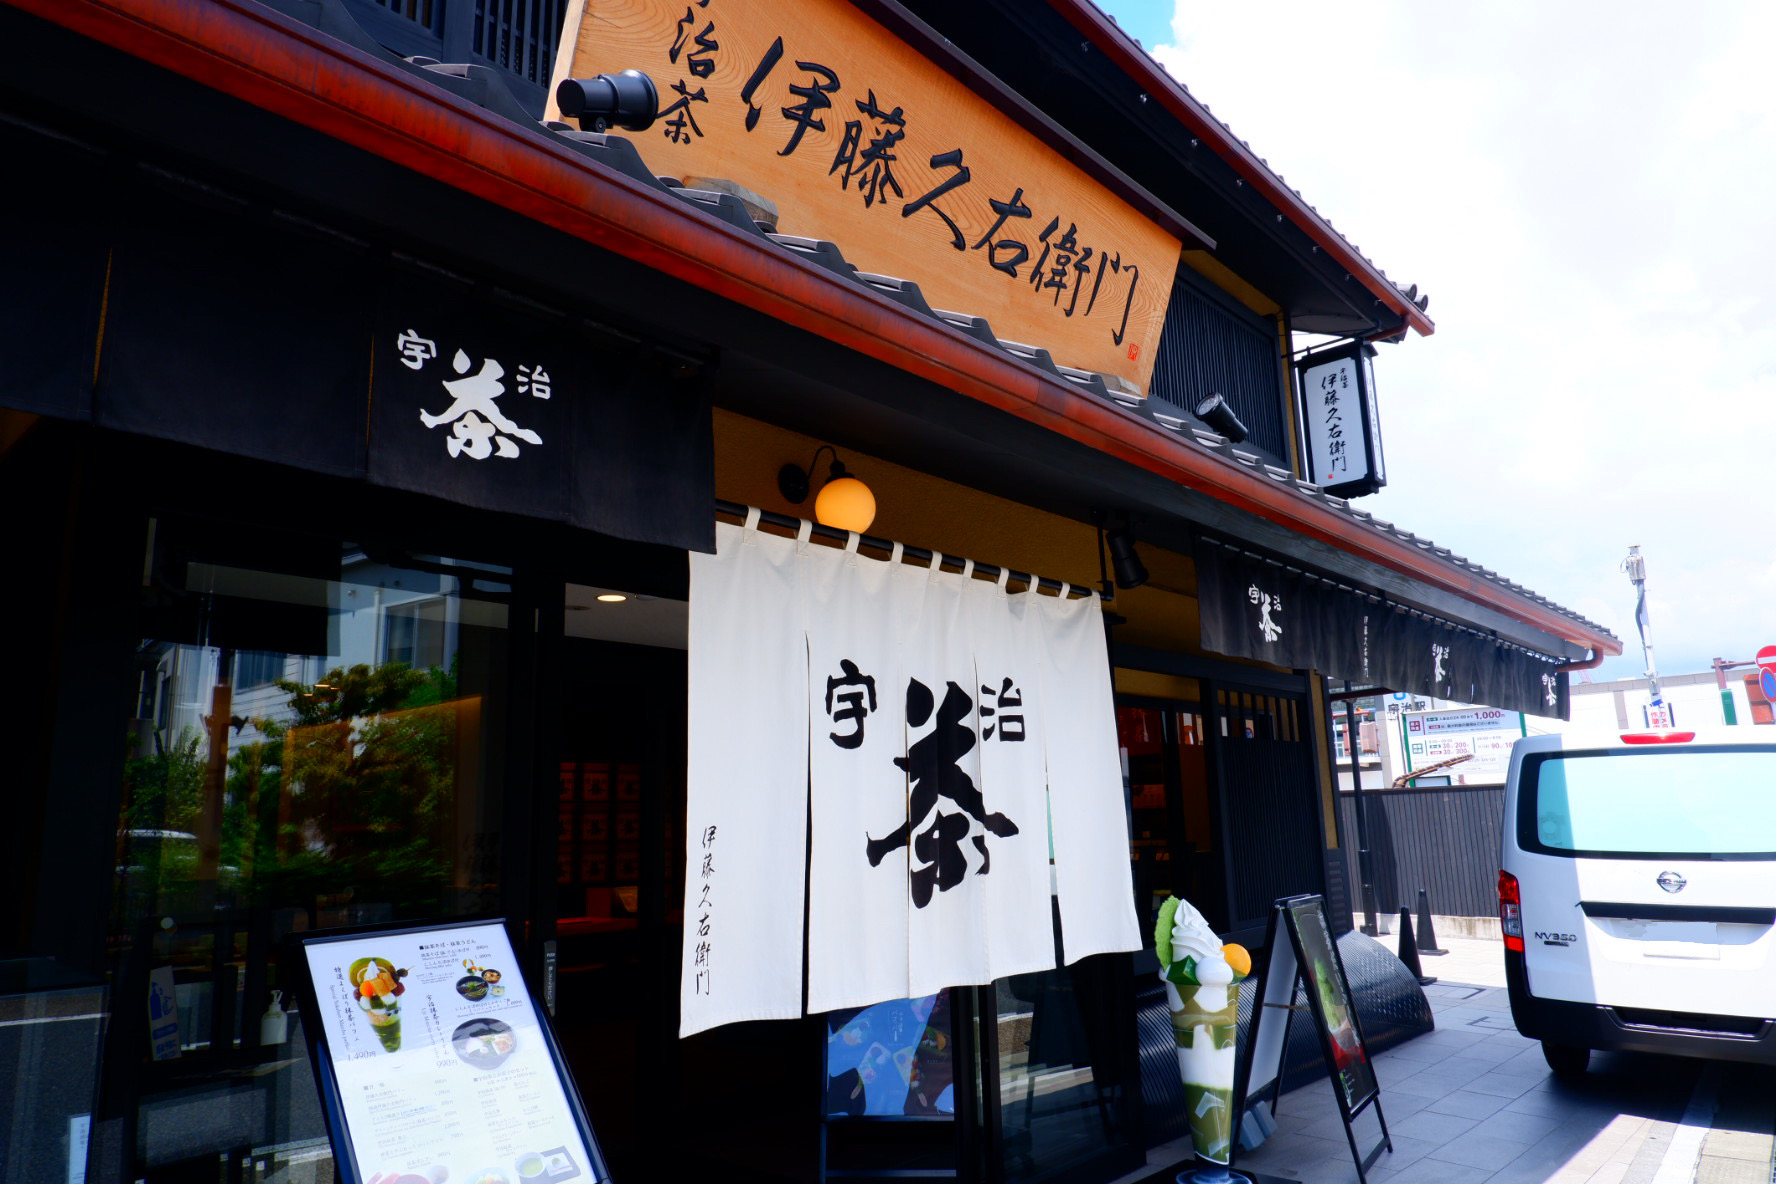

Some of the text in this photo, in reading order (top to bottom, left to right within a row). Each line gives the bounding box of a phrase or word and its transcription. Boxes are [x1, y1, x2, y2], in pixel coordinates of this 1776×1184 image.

[655, 0, 719, 145] 治茶
[741, 36, 1139, 346] 伊藤久右衛門
[1321, 373, 1347, 472] 伊藤久右衛門
[694, 825, 718, 996] 伊藤久右衛門
[1534, 931, 1578, 942] NV350
[347, 1050, 376, 1061] 1,490円
